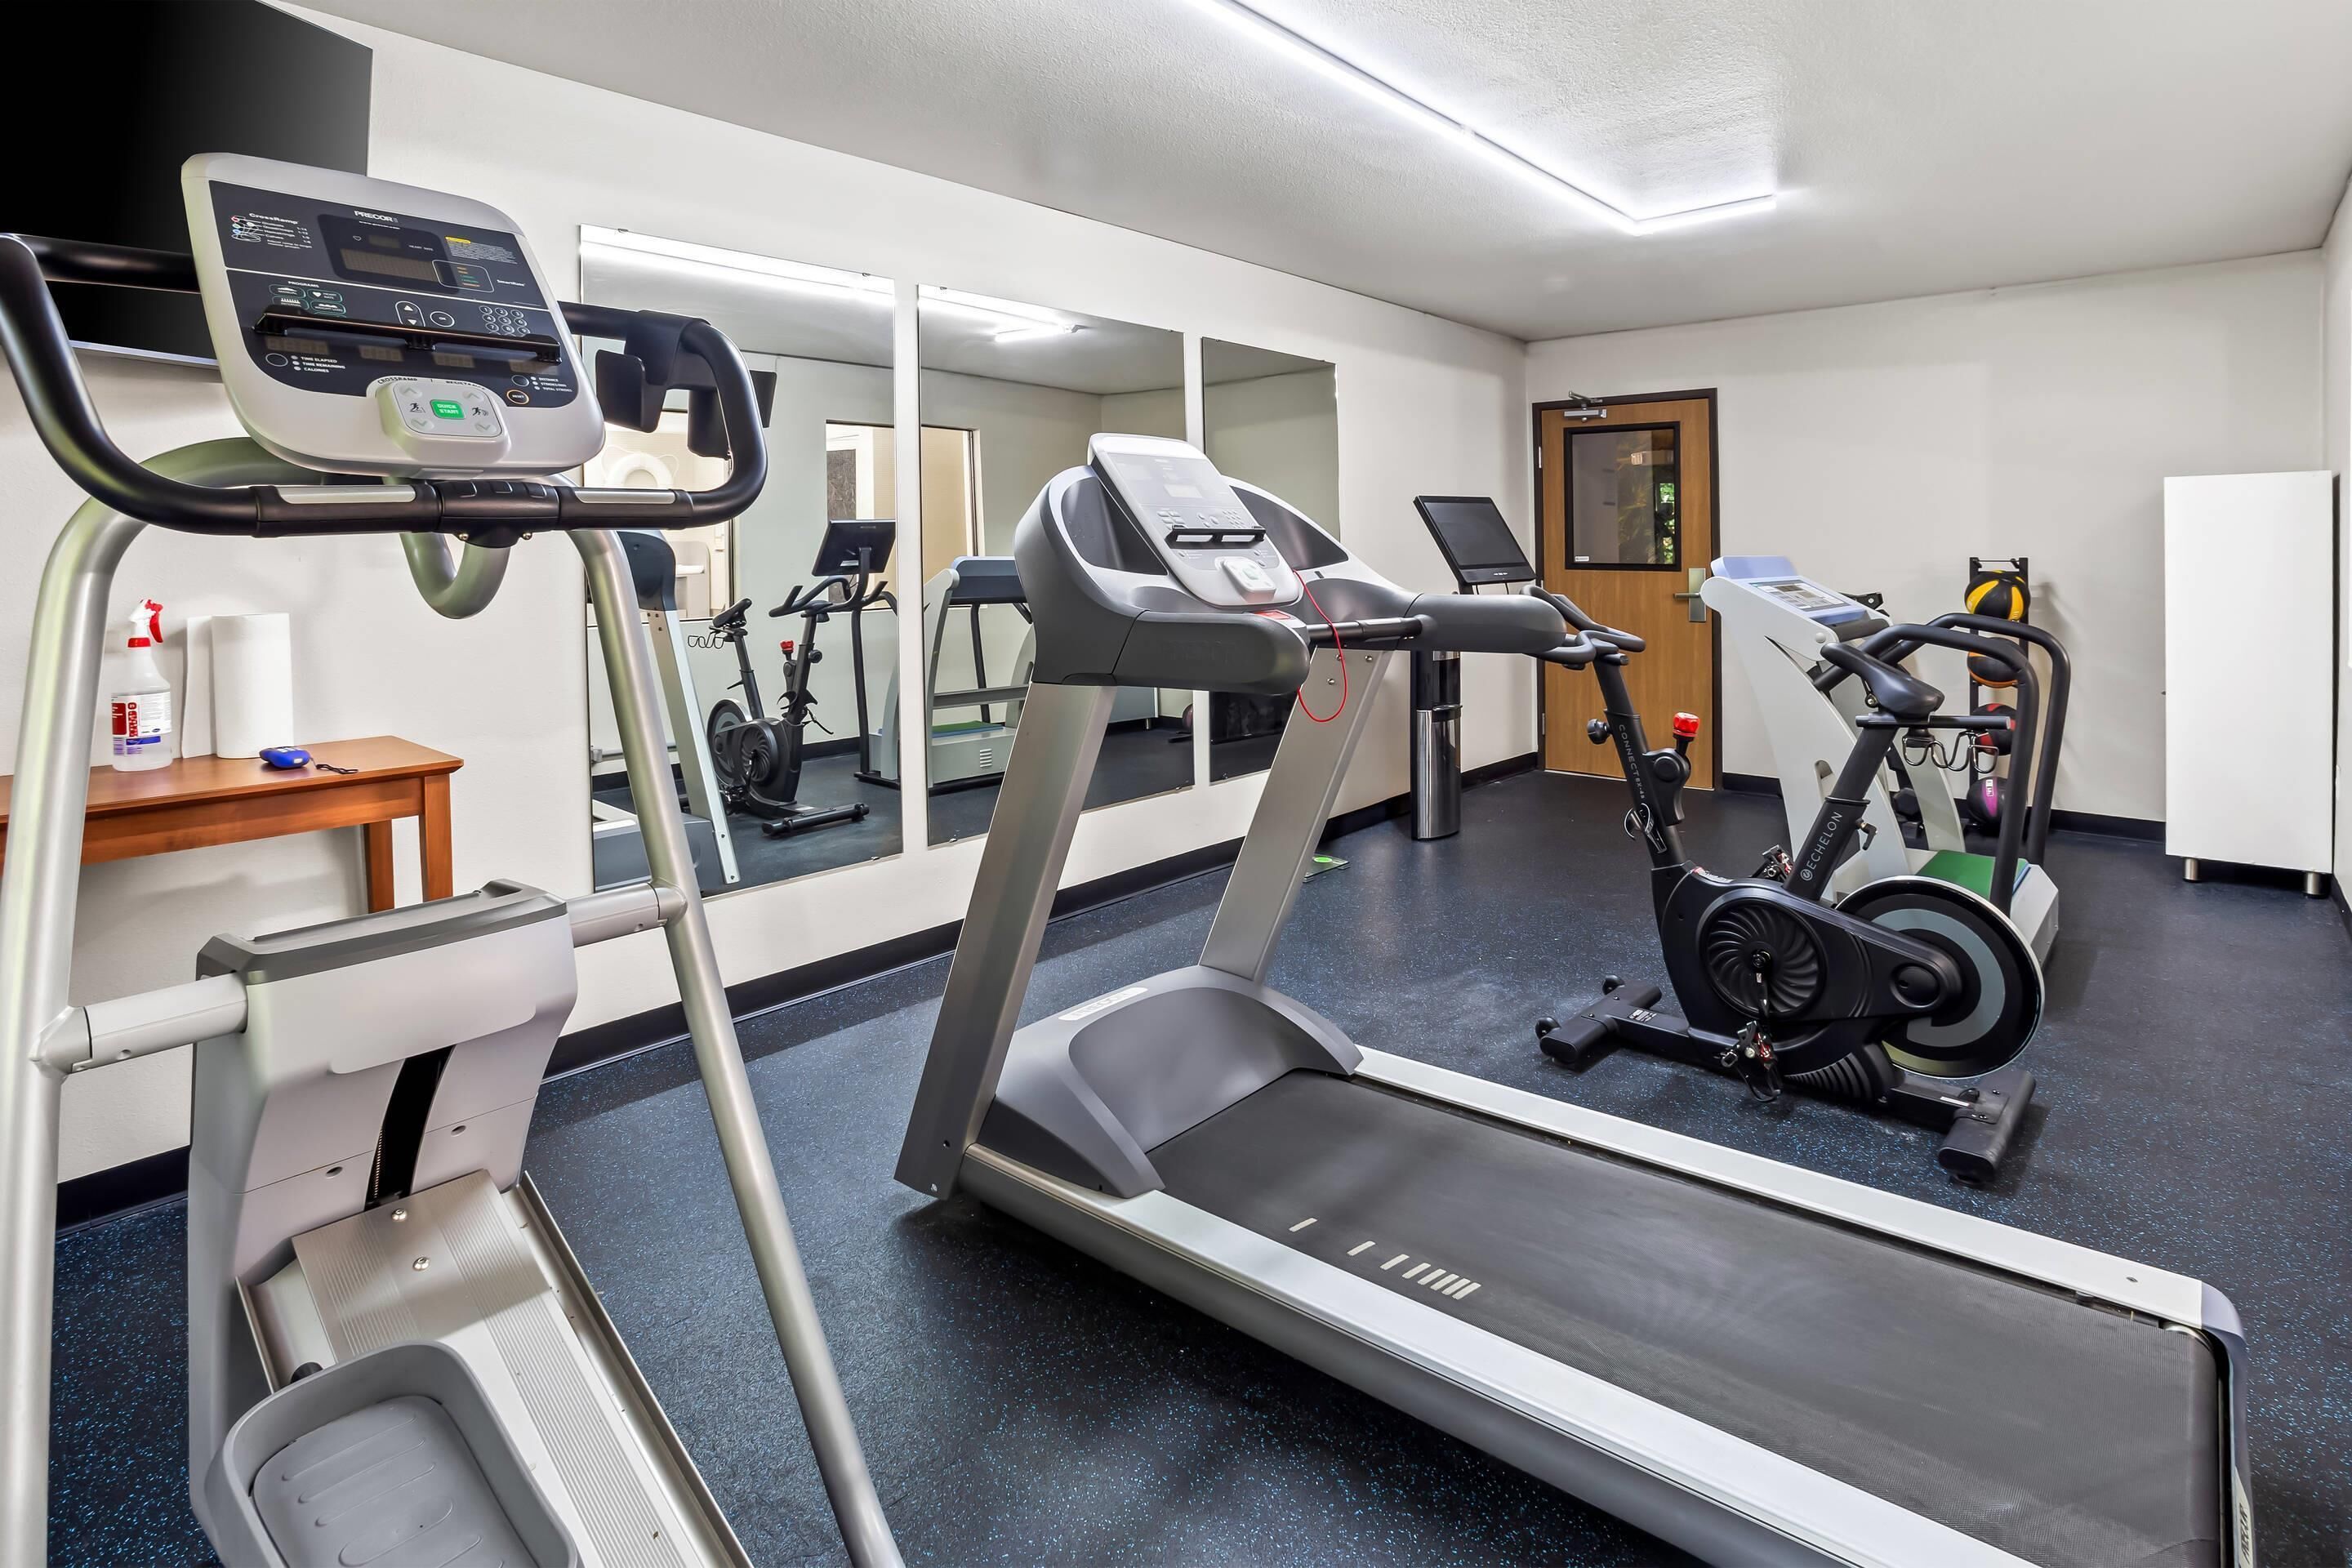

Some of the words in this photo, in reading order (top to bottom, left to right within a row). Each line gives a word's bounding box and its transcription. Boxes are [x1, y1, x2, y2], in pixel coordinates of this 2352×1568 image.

[249, 213, 298, 225] CrossRamp
[354, 210, 393, 222] PRECOR
[287, 280, 319, 288] PROGRAMS
[377, 376, 417, 385] CROSSRAMP
[1619, 724, 1640, 777] CONNECT
[1806, 812, 1843, 870] ECHELON
